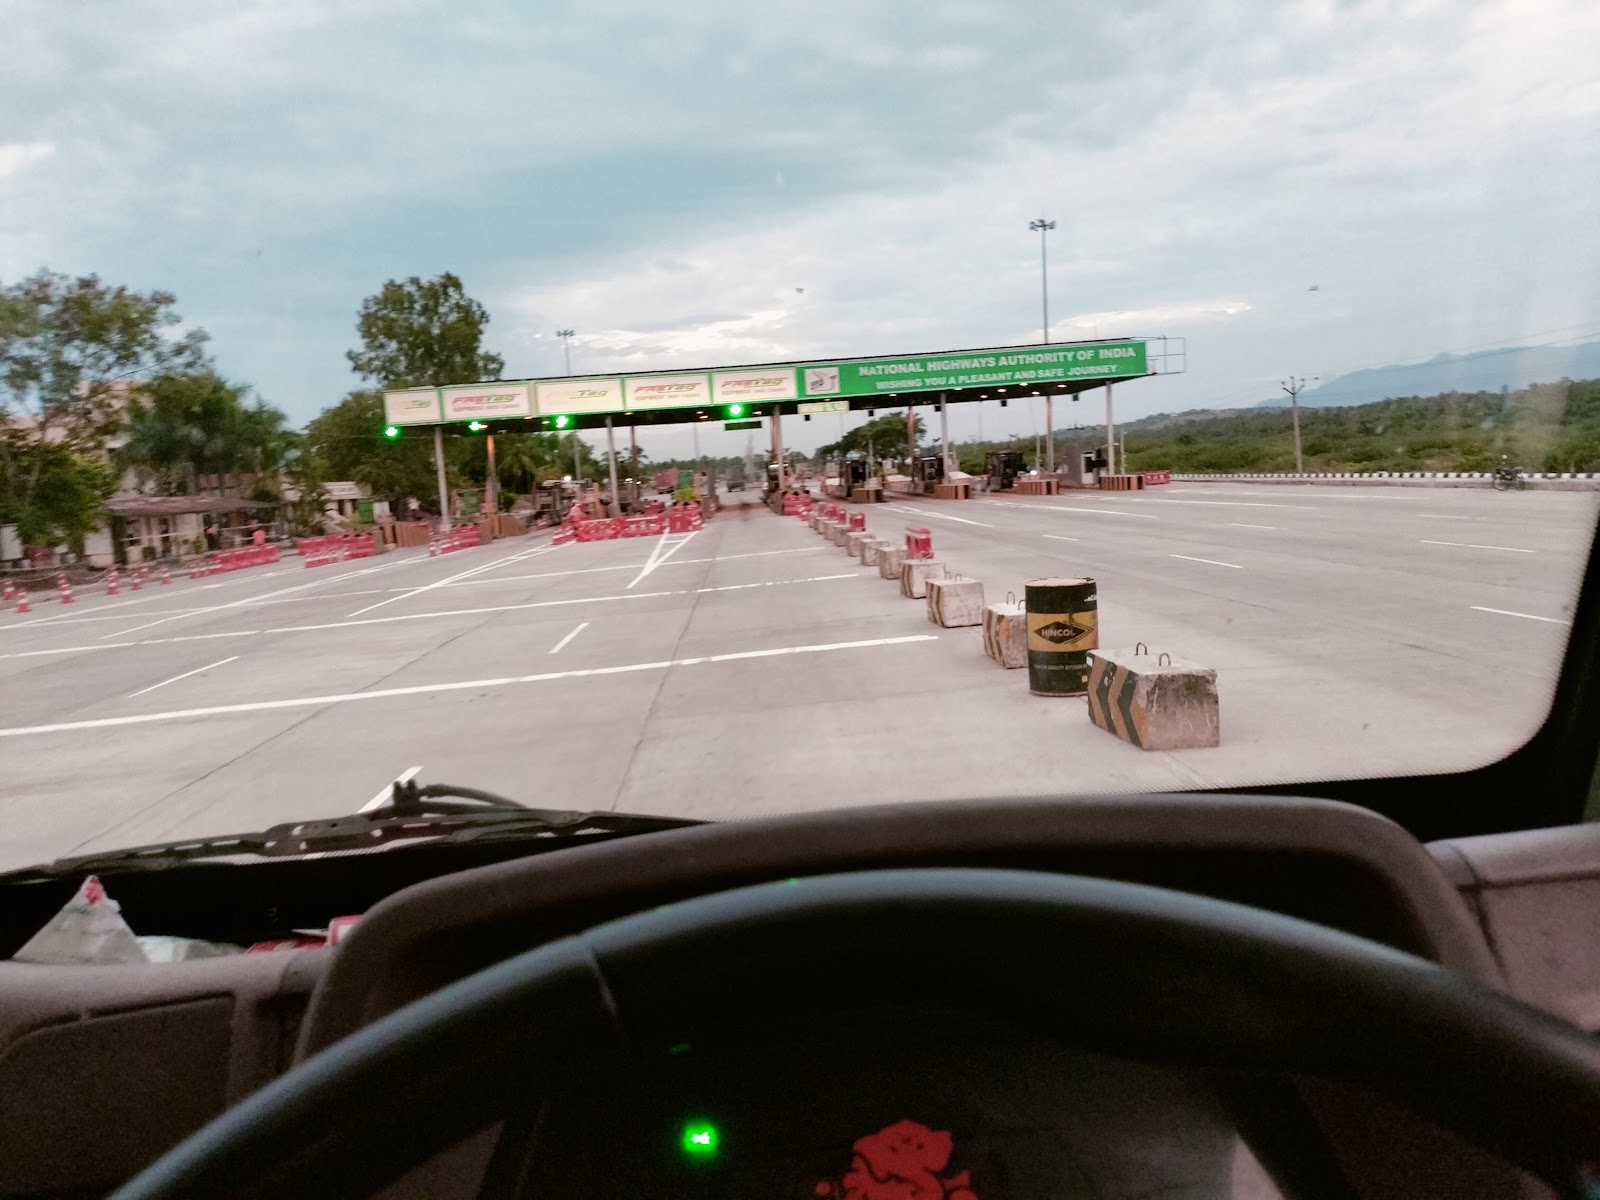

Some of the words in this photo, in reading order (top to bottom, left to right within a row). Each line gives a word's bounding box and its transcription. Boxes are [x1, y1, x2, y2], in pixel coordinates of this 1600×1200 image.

[859, 362, 924, 376] NATIONAL
[927, 357, 996, 371] HIGHWAYS
[998, 351, 1075, 366] AUTHORITY
[1076, 350, 1095, 360] OF
[1100, 347, 1136, 358] INDIA
[876, 378, 922, 389] WISHING
[924, 376, 947, 386] YOU
[947, 376, 957, 384] A
[958, 371, 1012, 383] PLEASANT
[1014, 370, 1036, 380] AND
[1036, 367, 1065, 377] SAFE
[1067, 364, 1118, 375] JOURNEY
[1041, 628, 1076, 637] HINCOL
